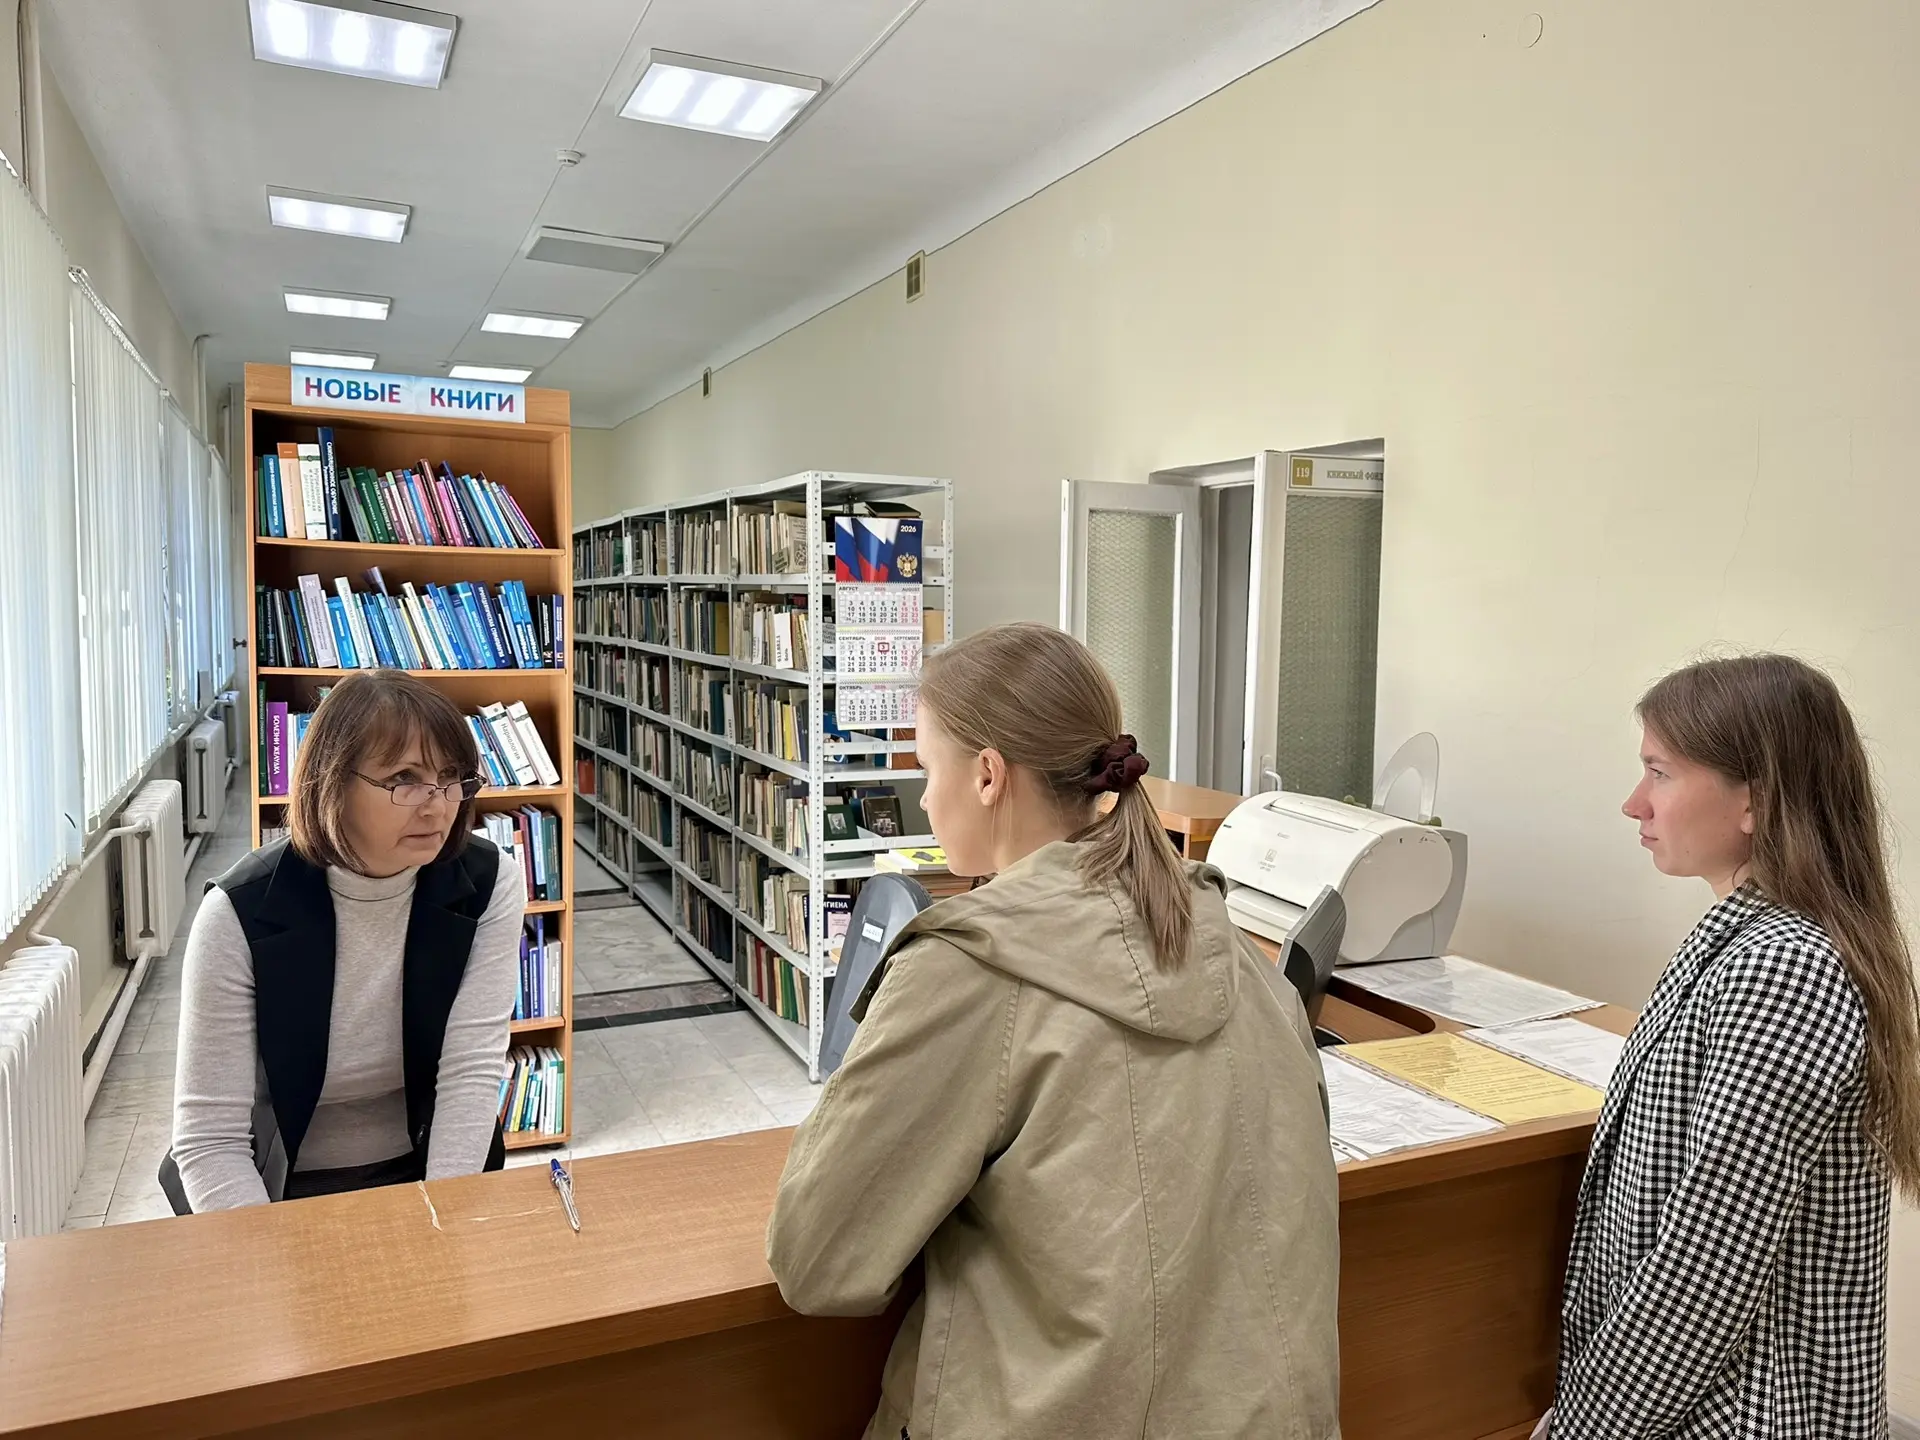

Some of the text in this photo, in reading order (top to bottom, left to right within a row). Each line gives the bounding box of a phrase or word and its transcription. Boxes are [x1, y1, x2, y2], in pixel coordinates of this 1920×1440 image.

[305, 376, 515, 413] НОВЫЕ КНИГИ
[1296, 467, 1310, 478] 119
[329, 488, 338, 515] ОБУЧЕНИЕ
[373, 481, 392, 531] ТРАНСПЛАНТОЛОГИЯ
[900, 525, 917, 533] 2026
[500, 722, 520, 760] Наркология
[273, 745, 281, 774] ЖЕЛУДКА
[823, 901, 848, 909] ИГИЕНА
